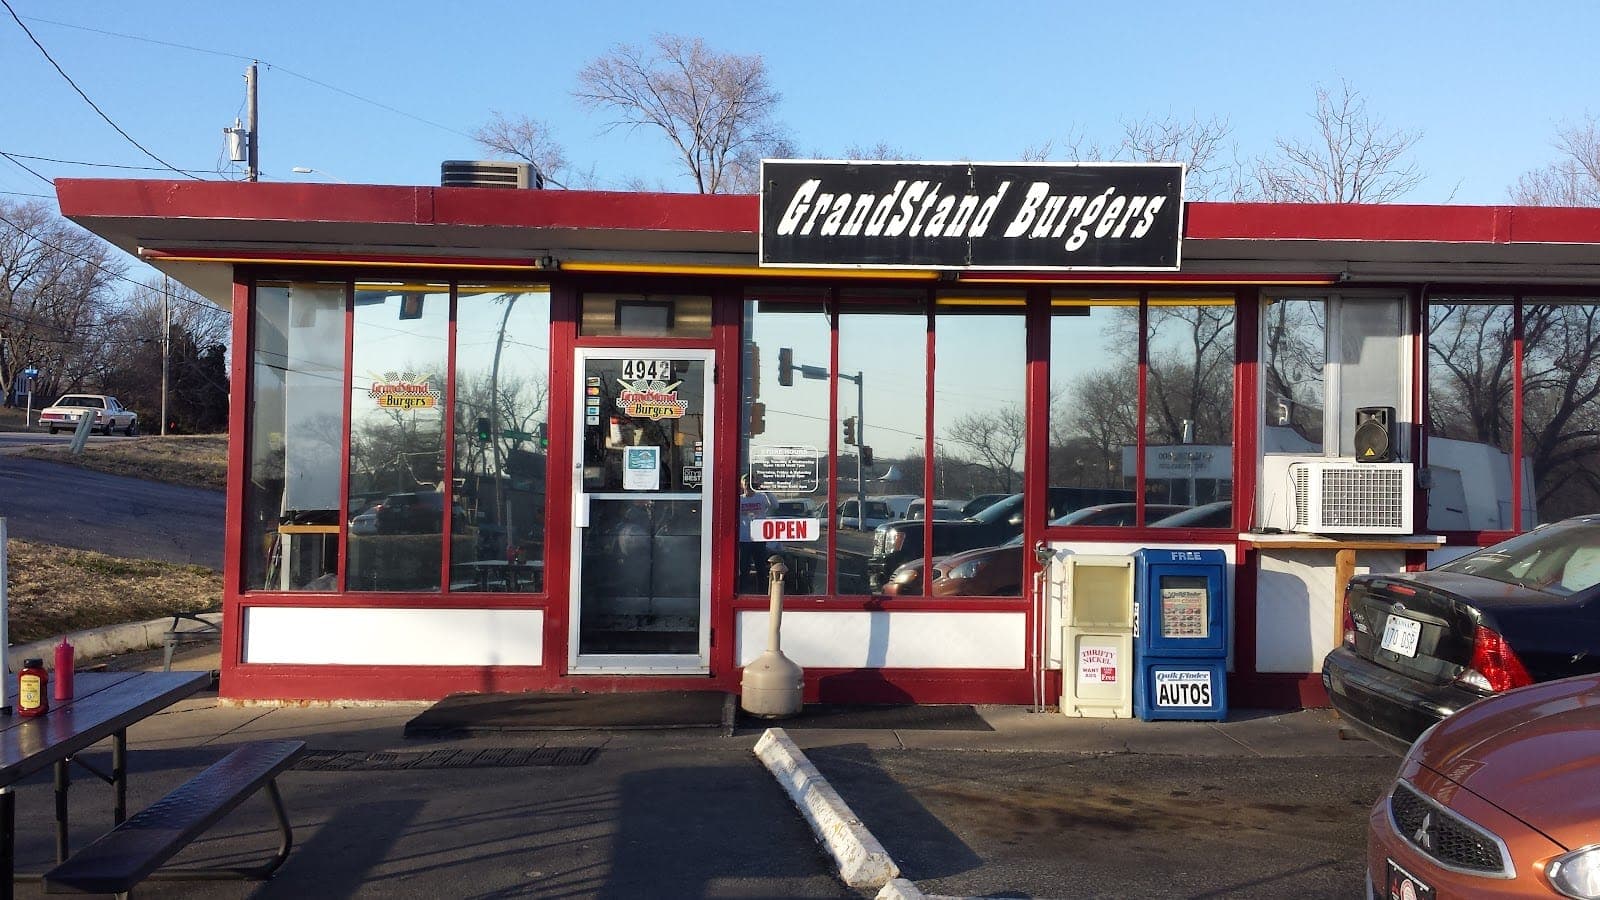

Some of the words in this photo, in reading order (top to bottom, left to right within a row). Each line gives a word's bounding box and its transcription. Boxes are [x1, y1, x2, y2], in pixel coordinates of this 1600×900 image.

[777, 178, 1010, 238] GrandStand
[1004, 181, 1167, 252] Burgers
[624, 360, 670, 379] 4942
[387, 395, 426, 409] Burgers
[635, 403, 674, 417] Burgers
[762, 520, 808, 540] OPEN
[1171, 551, 1202, 561] FREE
[1082, 649, 1115, 660] THRIFTY
[1083, 656, 1112, 665] NICKEL
[1156, 672, 1179, 682] Quik
[1178, 672, 1209, 681] Finder
[1159, 683, 1210, 705] AUTOS
